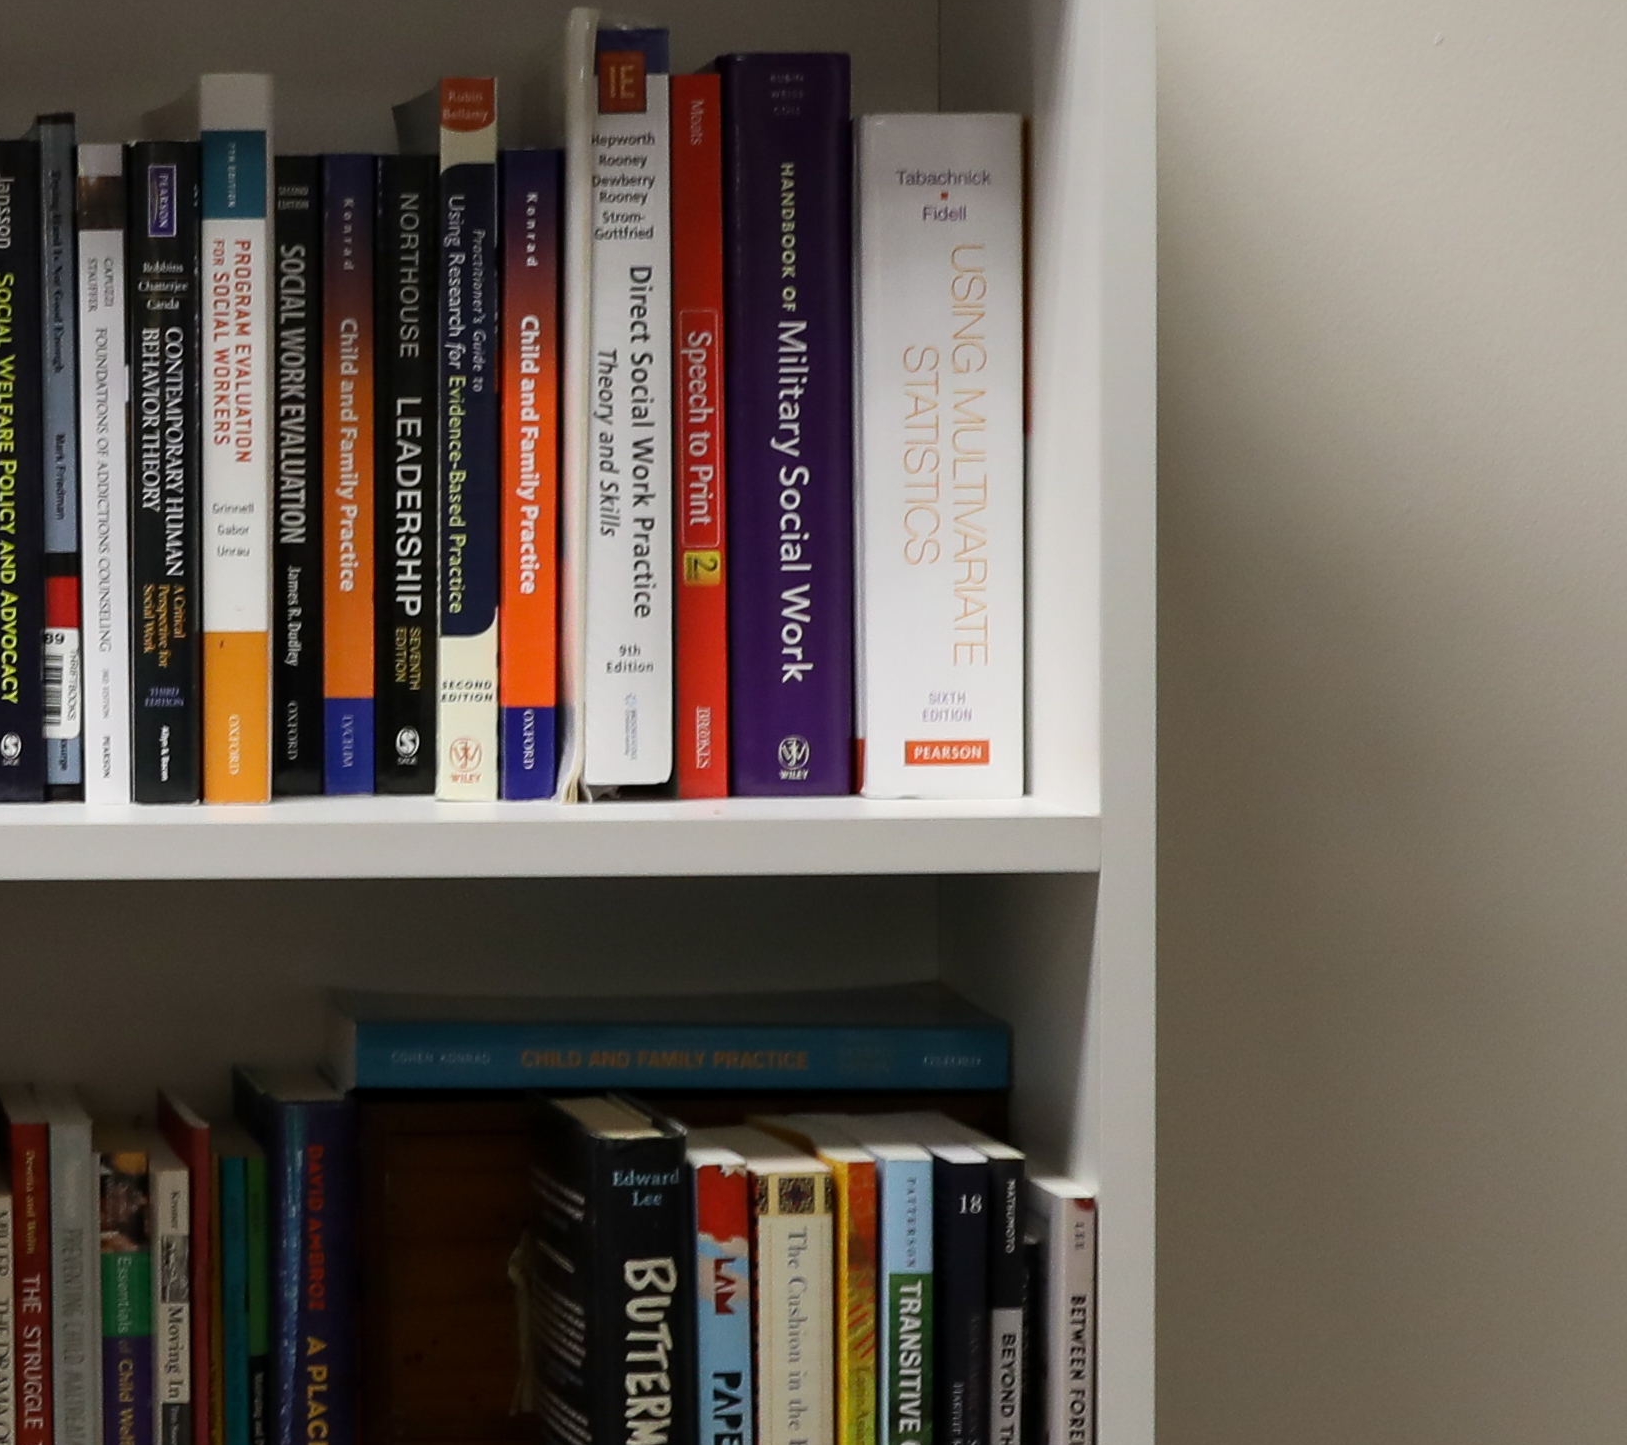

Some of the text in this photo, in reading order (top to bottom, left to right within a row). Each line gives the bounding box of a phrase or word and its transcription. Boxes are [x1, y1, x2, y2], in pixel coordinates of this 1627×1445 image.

[591, 134, 655, 144] Hepworth
[591, 176, 656, 189] Dewberry
[896, 170, 991, 185] Tabachnick
[157, 173, 168, 228] PEARSON
[922, 207, 967, 220] Fidell
[234, 240, 252, 463] PROGRAM EVALUATION
[280, 244, 306, 543] SOCIAL WORK EVALUATION
[141, 326, 160, 512] BEHAVIOR THEORY
[395, 193, 422, 617] NORTHOUSE LEADERSHIP
[593, 349, 620, 536] Theory and Skills
[630, 266, 657, 618] Direct Social Work Practice
[682, 331, 713, 526] Speech to Print
[771, 163, 814, 684] HANDBOOK OF Military Social Work
[55, 433, 68, 520] Mark Friedman
[164, 326, 184, 576] CONTEMPORARY HUMAN
[516, 315, 540, 594] Child and Family Practice
[904, 346, 940, 565] STATISTICS
[951, 244, 988, 666] USING MULTIVARIATE
[0, 591, 19, 704] ADVOCACY
[102, 736, 111, 778] PEARSON
[228, 713, 240, 775] OXFORD
[914, 746, 982, 759] PEARSON
[611, 1168, 680, 1186] Edward
[632, 1190, 663, 1205] Lee
[958, 1194, 983, 1214] 18
[1005, 1179, 1016, 1254] MATSUMOTO
[307, 1144, 325, 1311] DAVID AMBROZ
[906, 1177, 918, 1269] PATTERSON
[1074, 1222, 1084, 1250] LEE
[21, 1272, 41, 1314] THE
[714, 1258, 737, 1315] LAM
[23, 1326, 42, 1429] STRUGGLE
[306, 1337, 328, 1355] A
[898, 1279, 922, 1433] TRANSITIVE
[1001, 1333, 1015, 1418] BEYOND
